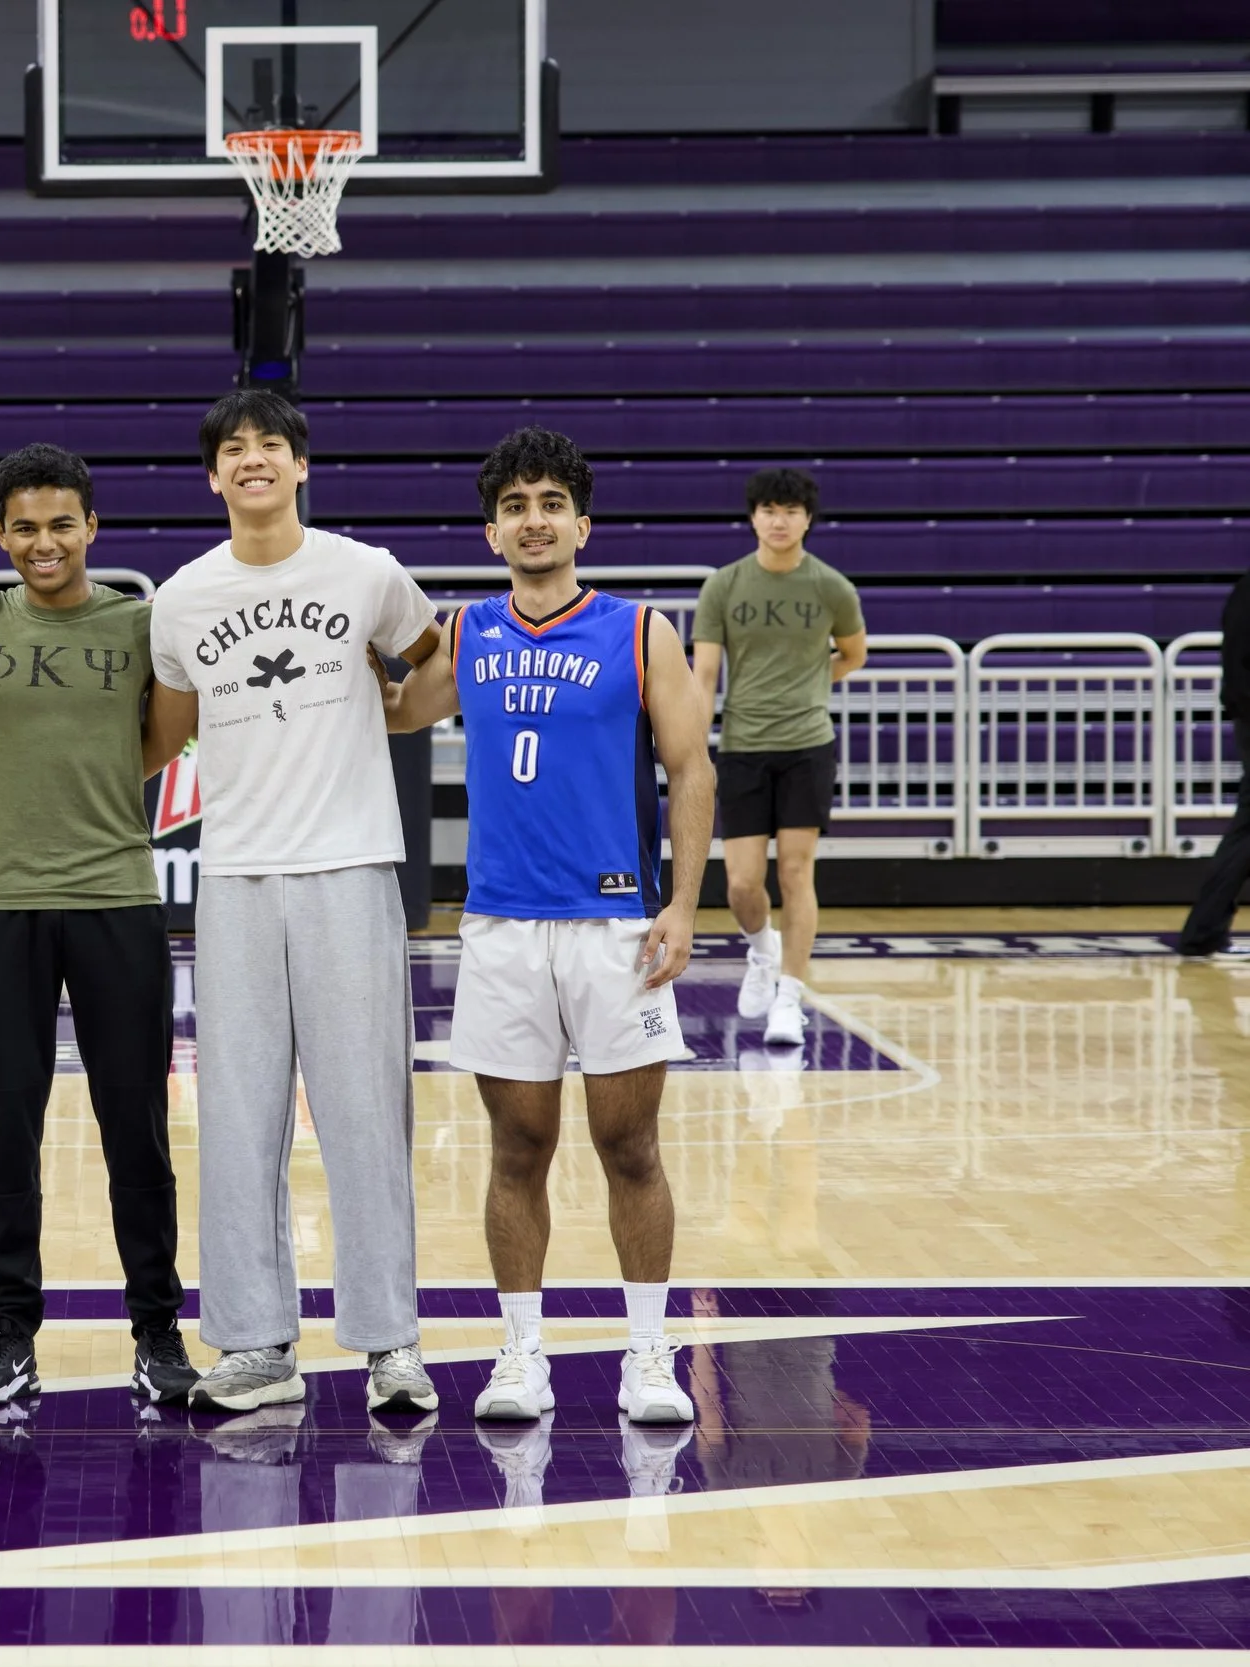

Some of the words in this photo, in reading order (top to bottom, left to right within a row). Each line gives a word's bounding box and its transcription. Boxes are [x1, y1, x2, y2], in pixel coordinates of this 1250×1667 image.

[196, 597, 350, 666] CHICAGO
[314, 660, 343, 676] 2025
[474, 648, 603, 691] OKLAHOMA
[211, 681, 239, 698] 1900
[299, 700, 325, 710] CHICAGO
[503, 684, 559, 715] CITY
[217, 718, 243, 728] SEASONS
[512, 728, 541, 784] 0
[639, 1006, 662, 1018] VARSITY
[645, 1027, 667, 1039] TENNIS
